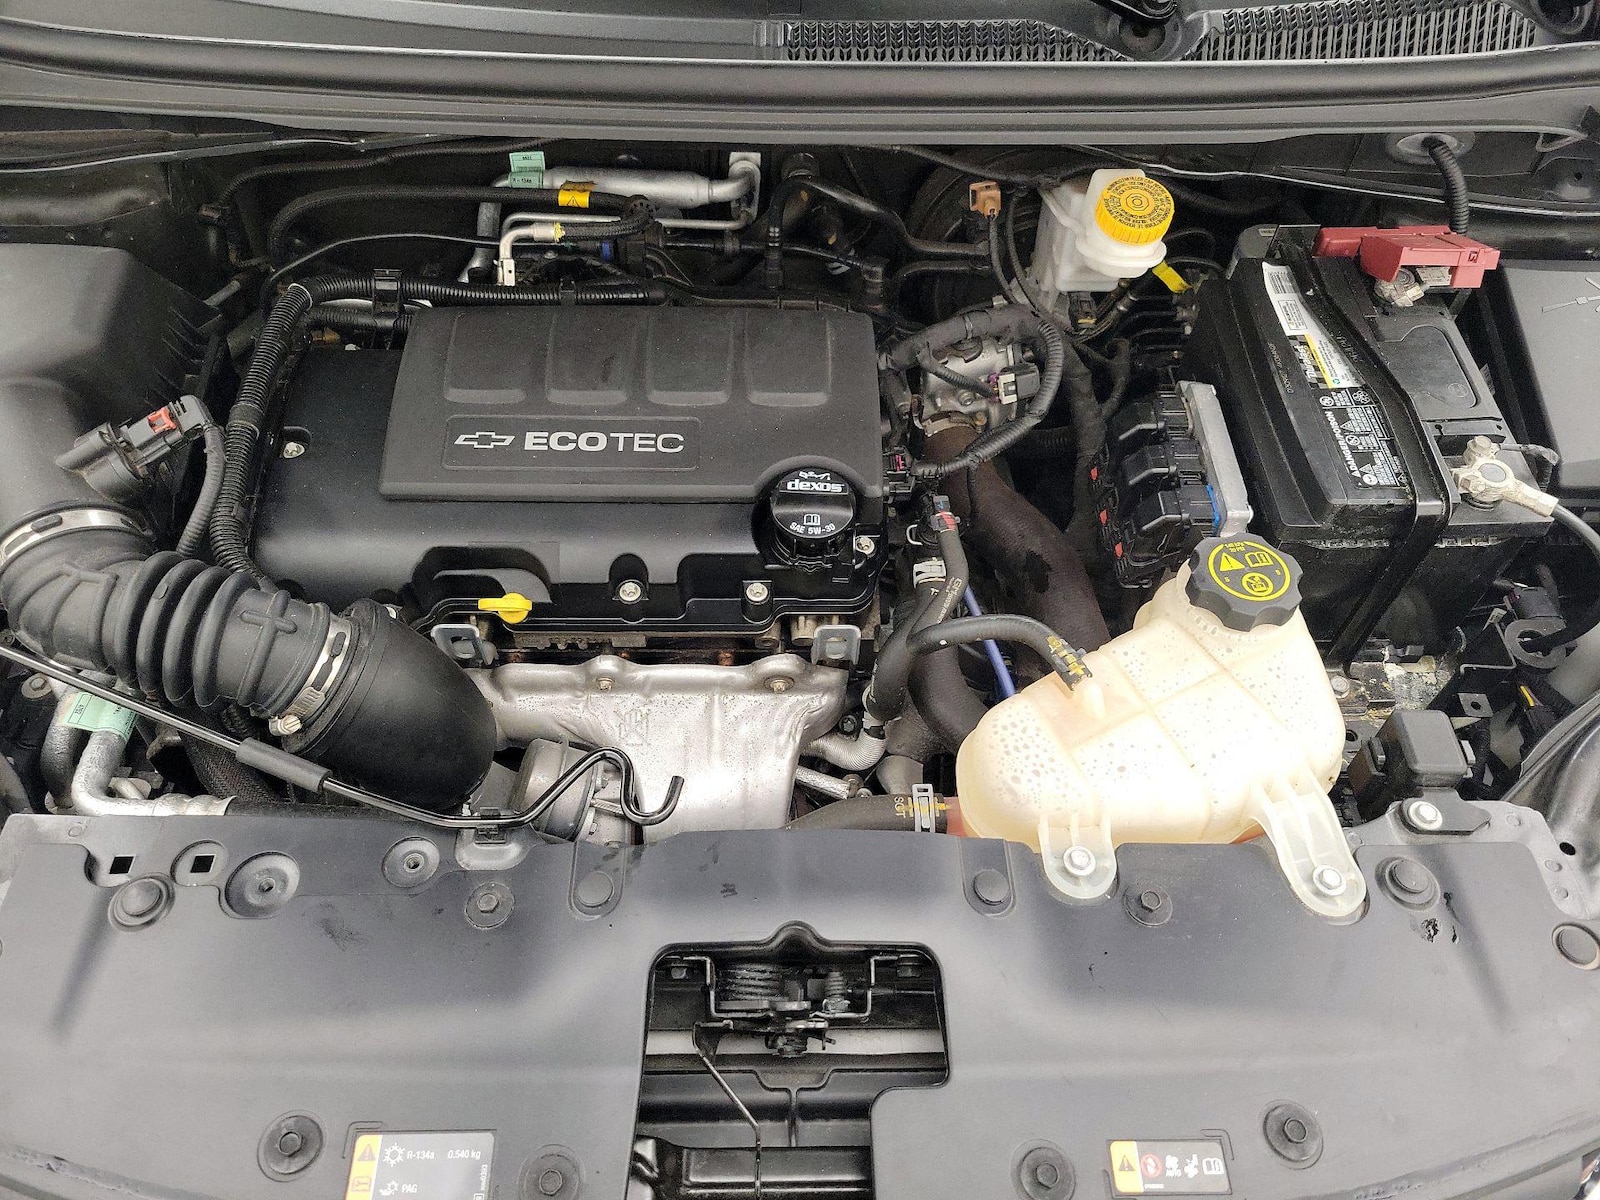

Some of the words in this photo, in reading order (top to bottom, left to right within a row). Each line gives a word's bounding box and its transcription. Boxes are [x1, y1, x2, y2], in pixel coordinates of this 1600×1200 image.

[1294, 344, 1317, 379] Duralast
[524, 431, 685, 453] ECOTEC
[786, 479, 845, 493] dexos
[789, 522, 806, 534] SAE
[808, 523, 836, 535] 5W-30
[406, 1150, 435, 1160] R-134a
[447, 1150, 470, 1159] 0.540
[470, 1149, 481, 1160] kg
[401, 1183, 418, 1194] PAG
